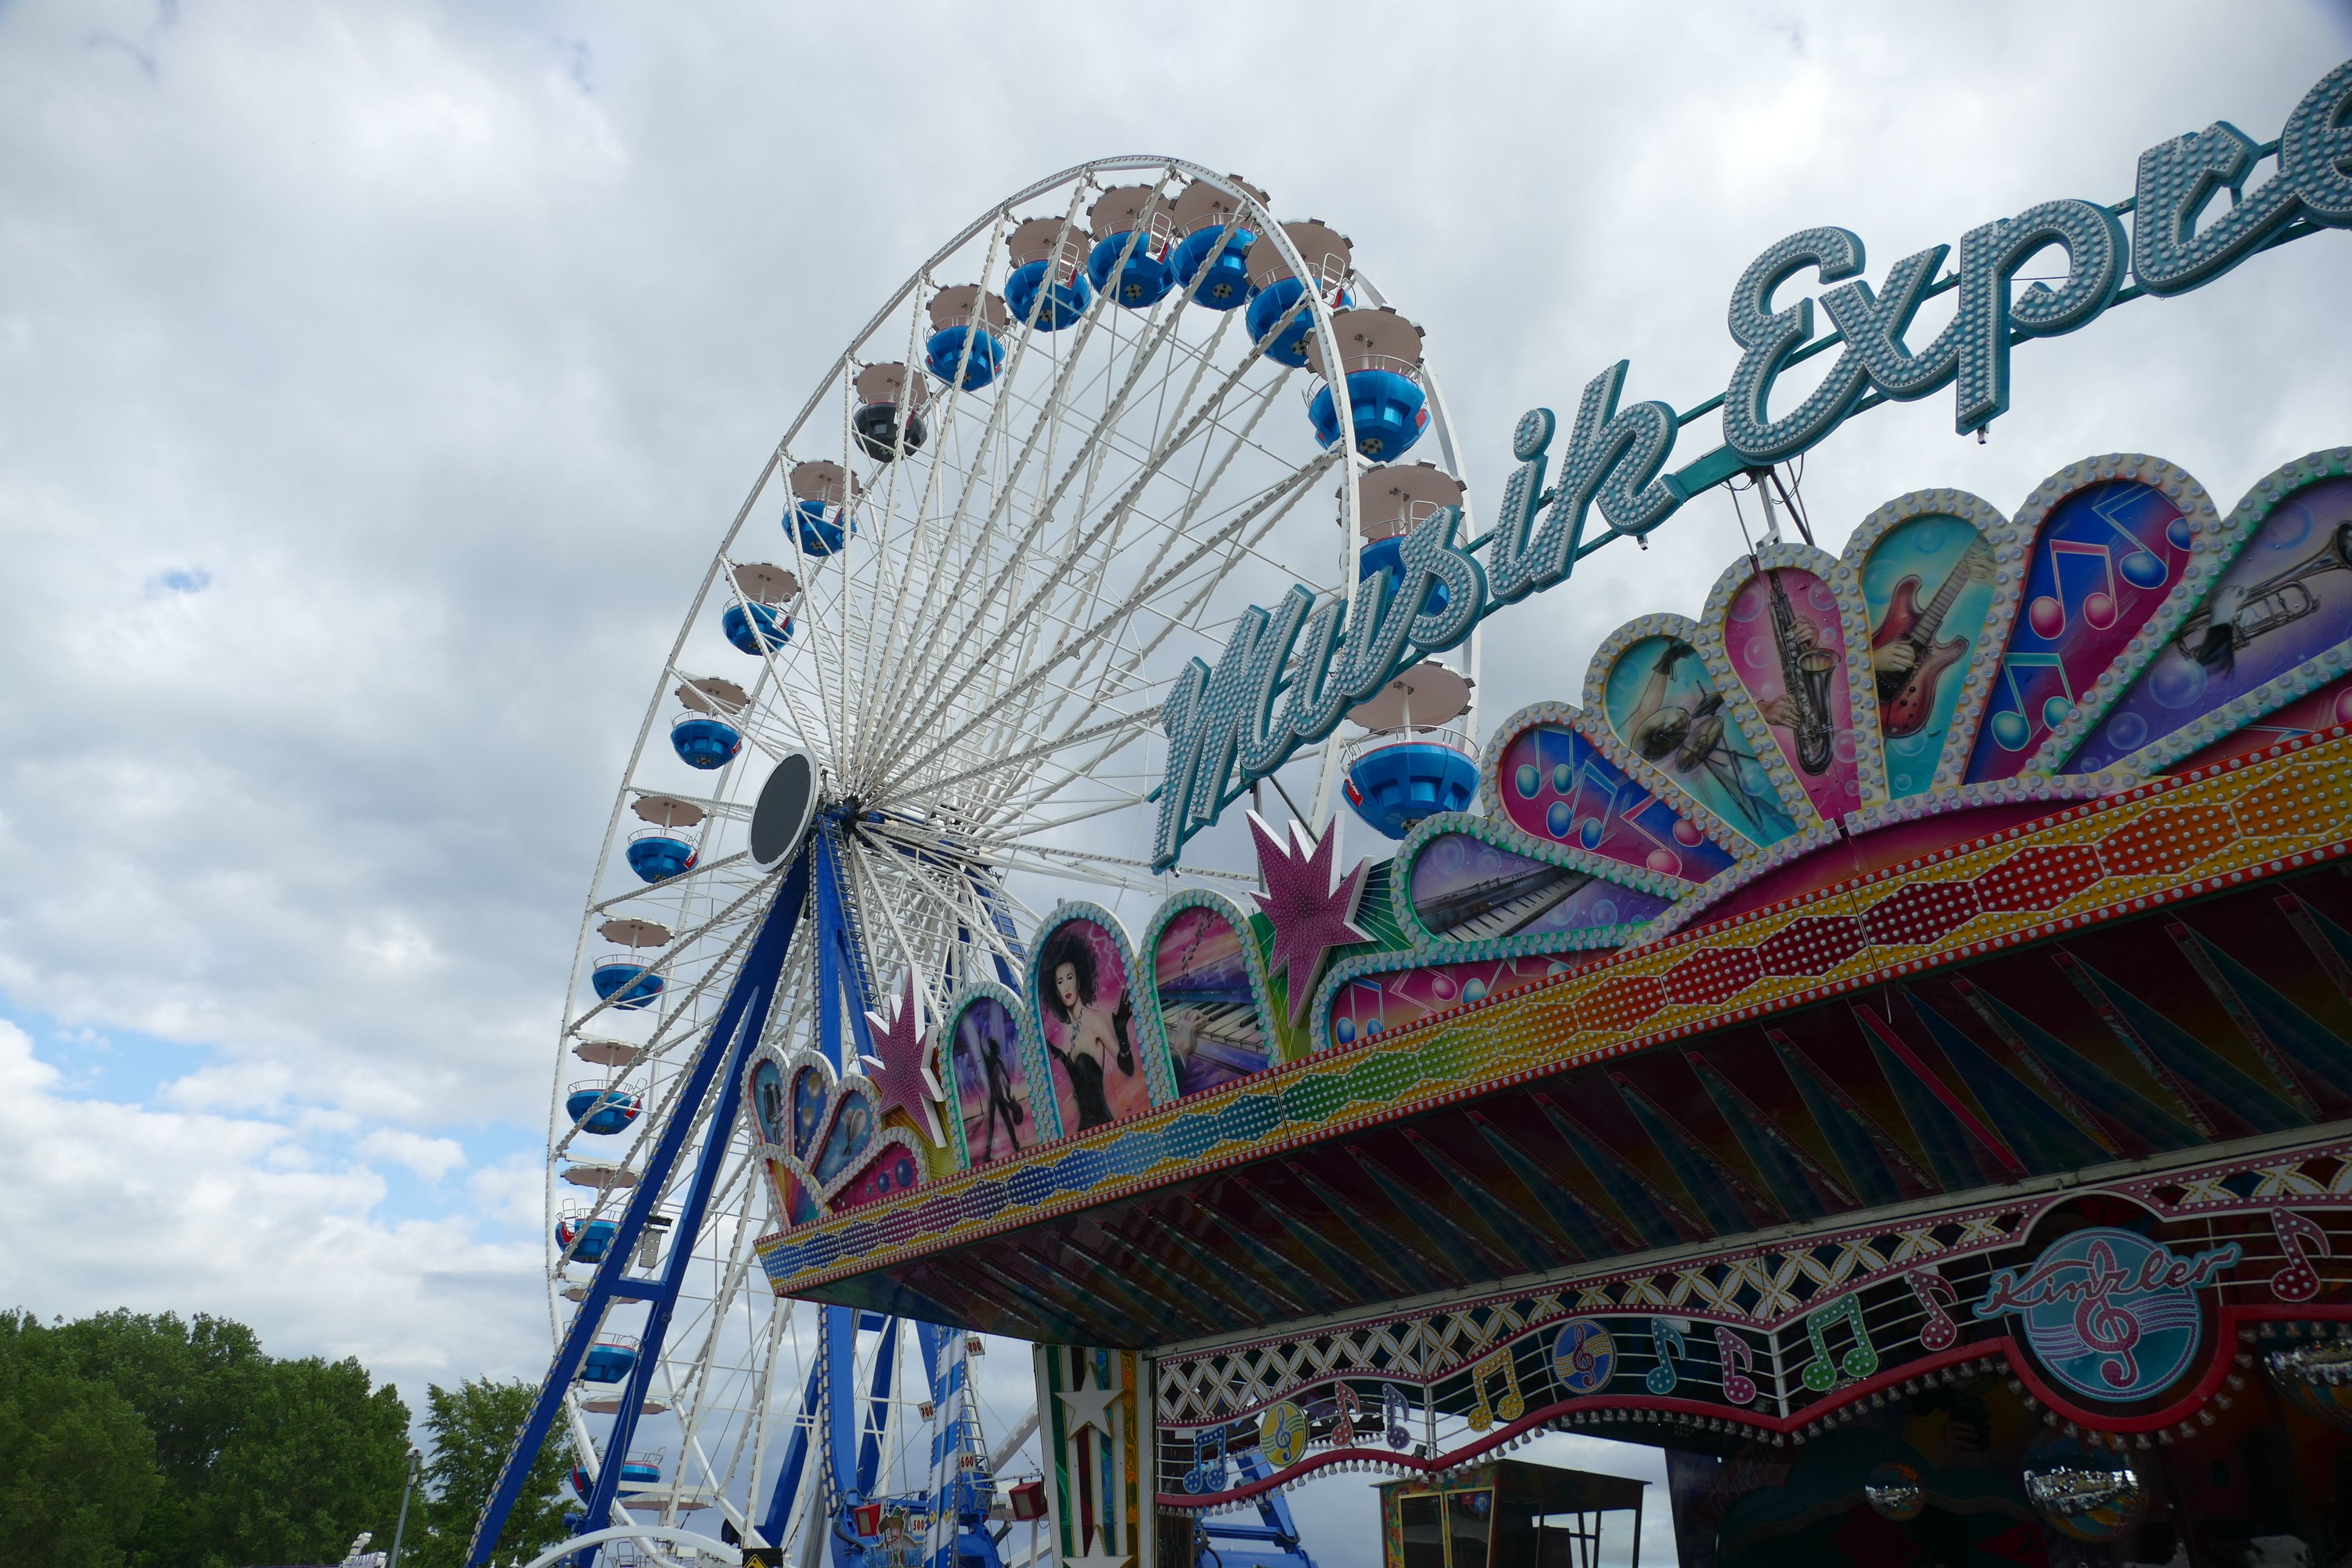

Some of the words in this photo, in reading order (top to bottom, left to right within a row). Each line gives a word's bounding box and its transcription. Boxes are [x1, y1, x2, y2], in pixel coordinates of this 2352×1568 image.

[1151, 359, 1689, 876] Musik
[968, 1341, 981, 1353] 800
[920, 1405, 933, 1417] 700
[960, 1456, 974, 1469] 600
[912, 1519, 925, 1531] 500
